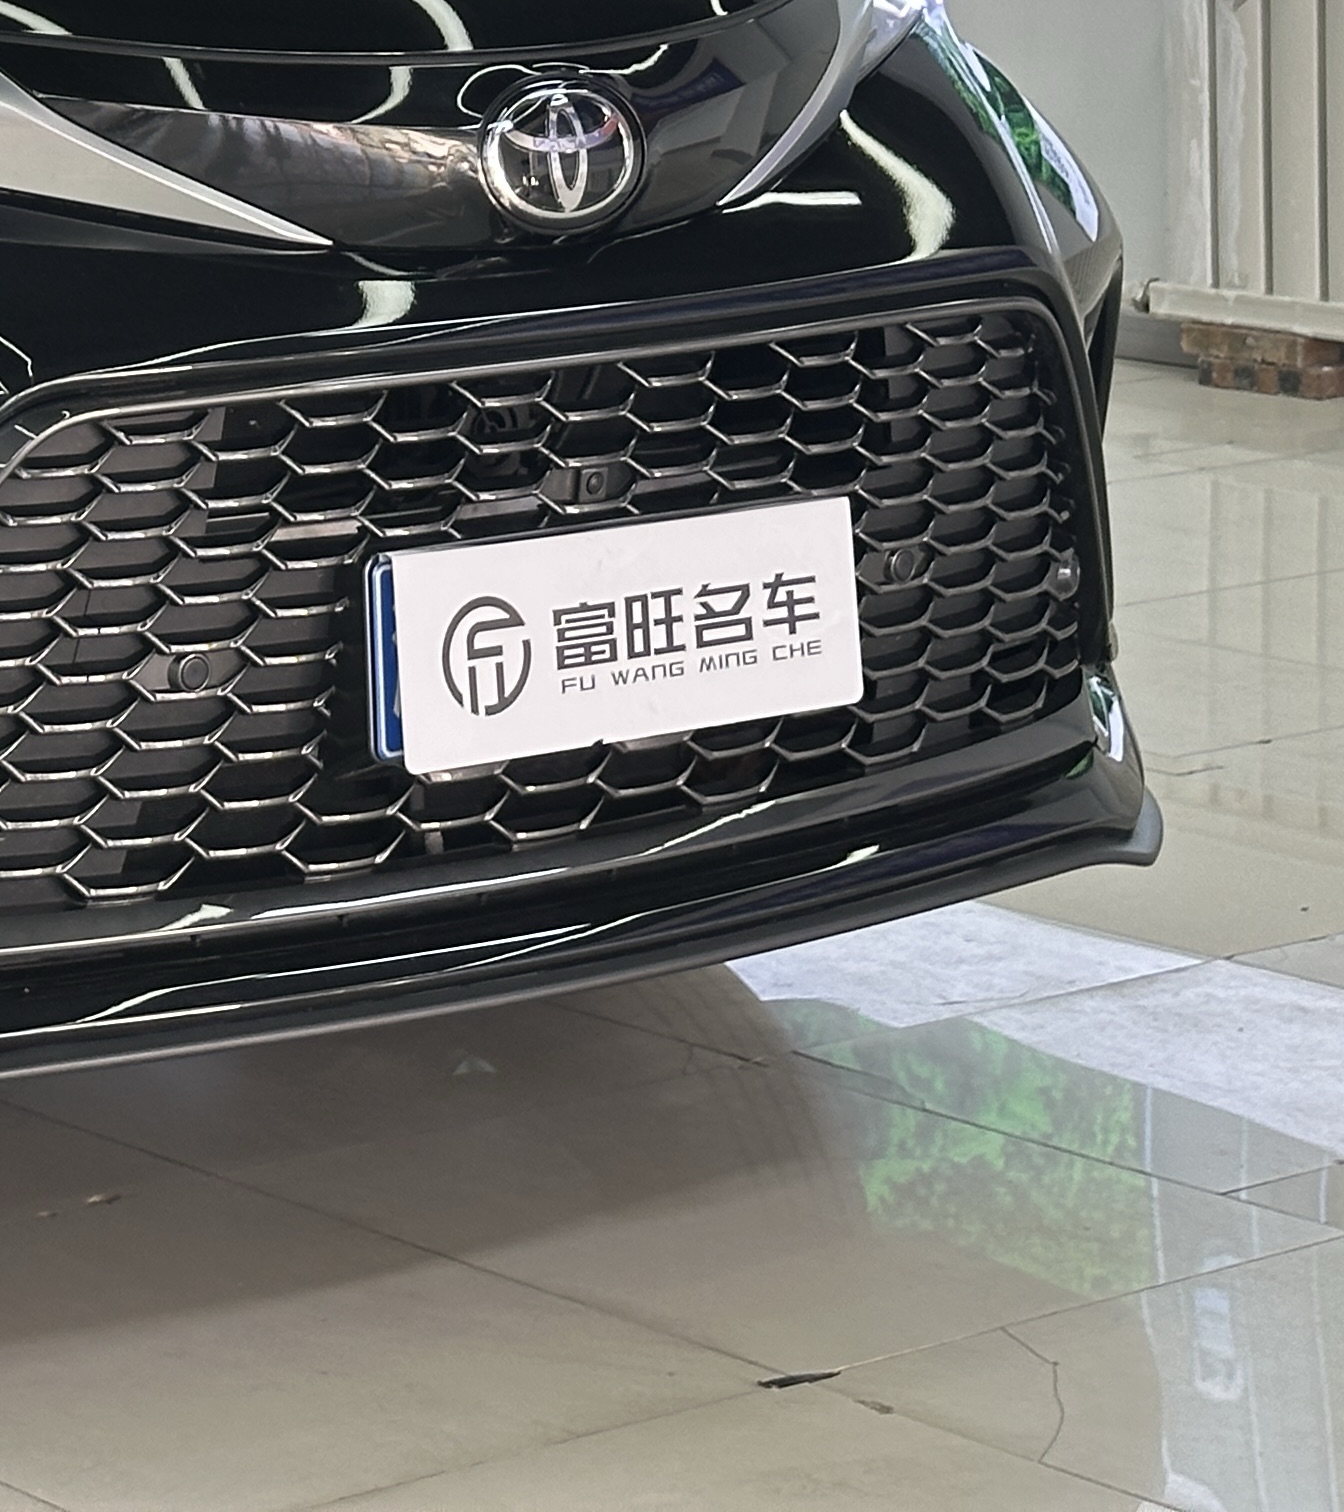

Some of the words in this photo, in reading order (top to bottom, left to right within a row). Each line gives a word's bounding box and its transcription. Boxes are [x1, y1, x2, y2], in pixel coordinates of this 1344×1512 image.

[552, 572, 821, 670] 富旺名车
[561, 675, 596, 694] FU
[611, 661, 684, 686] WANG
[699, 650, 758, 673] MING
[772, 640, 823, 662] CHE
